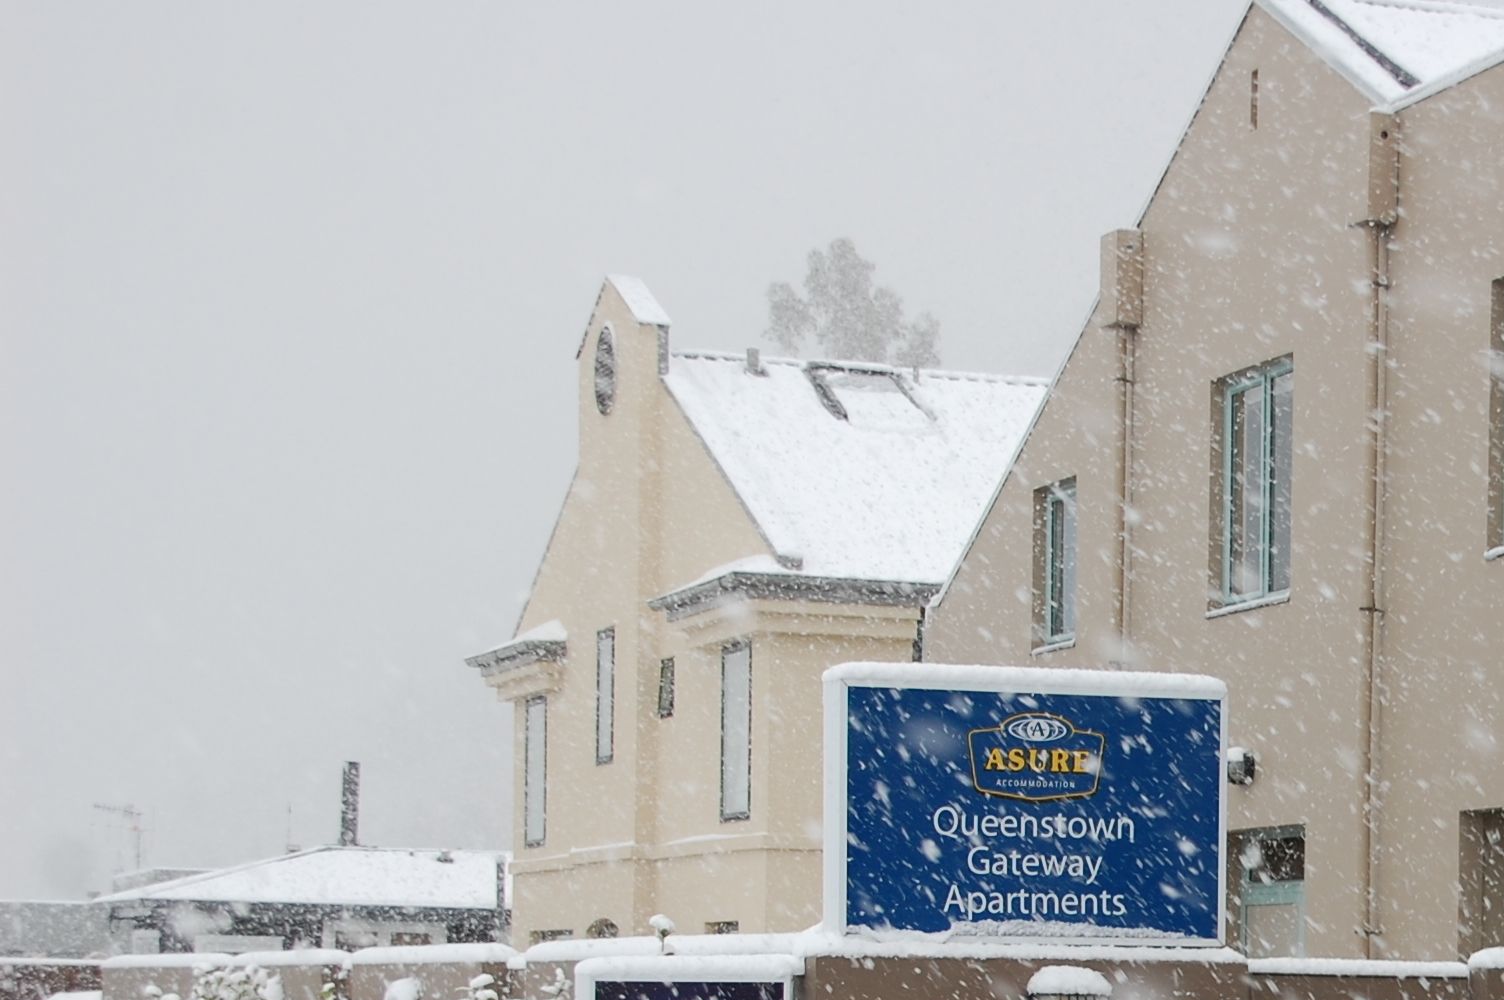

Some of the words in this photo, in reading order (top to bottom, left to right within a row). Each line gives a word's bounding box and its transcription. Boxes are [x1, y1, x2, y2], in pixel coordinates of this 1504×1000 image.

[985, 747, 1092, 773] ASURE
[995, 778, 1076, 789] ACCOMMODATION
[932, 805, 1135, 841] Queenstown
[967, 845, 1103, 883] Gateway
[943, 884, 1126, 920] Apartments
